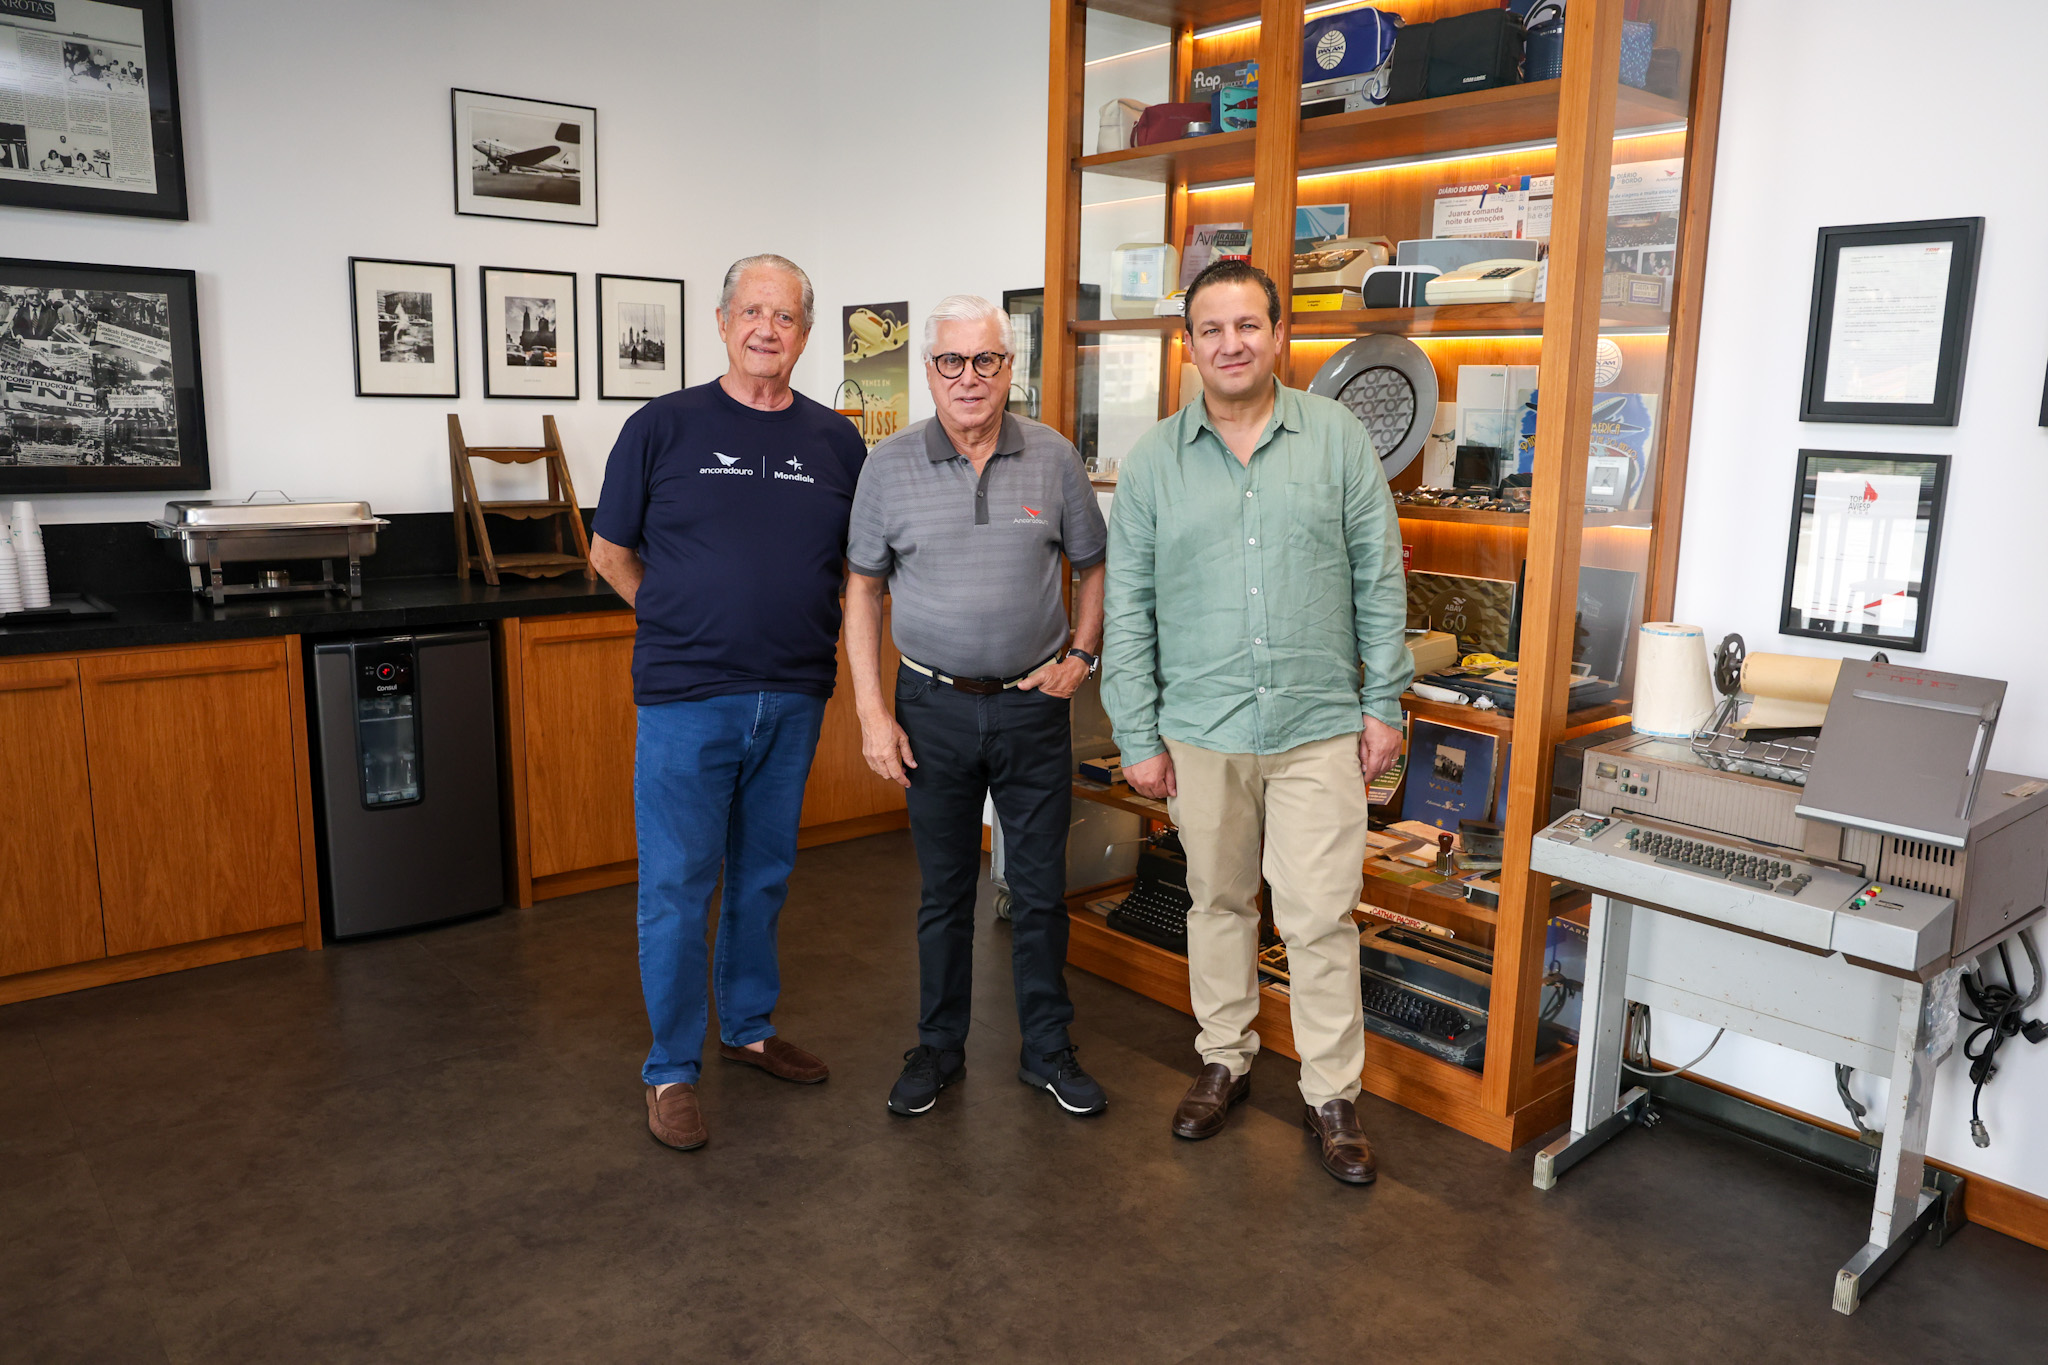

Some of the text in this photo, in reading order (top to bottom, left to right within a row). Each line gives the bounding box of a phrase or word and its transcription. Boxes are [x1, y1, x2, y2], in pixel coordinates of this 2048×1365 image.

[1194, 71, 1221, 91] flap
[1438, 184, 1489, 195] DIÁRIO DE BORDO
[1448, 207, 1503, 218] Juarez comanda
[1445, 214, 1505, 225] noite de emoções
[1219, 233, 1246, 241] RADAR
[699, 466, 815, 484] ancoradouro Mondiale
[1848, 502, 1871, 512] AVIESP
[1445, 603, 1464, 612] ABAV
[1442, 612, 1467, 632] 60
[376, 683, 398, 692] Consul
[1372, 907, 1421, 929] CATHAY PACIFIC
